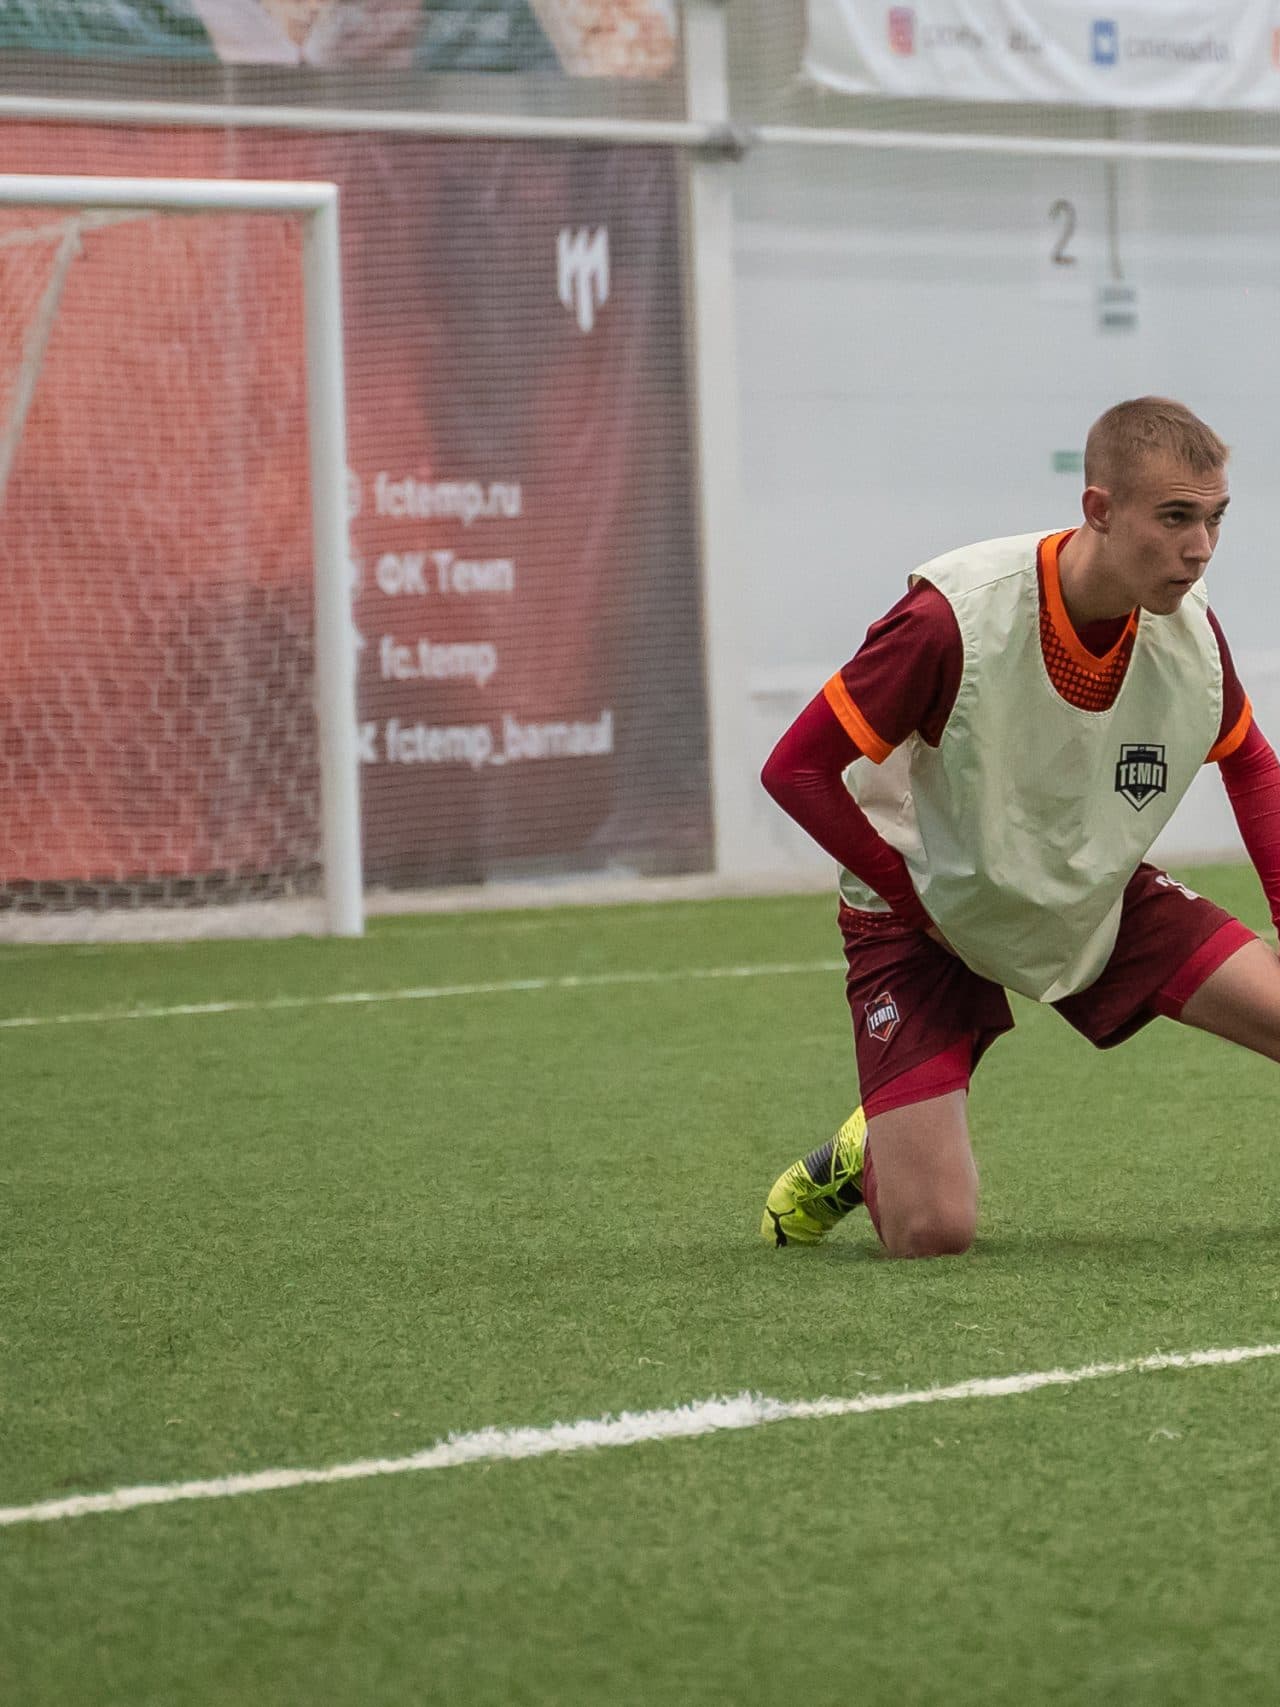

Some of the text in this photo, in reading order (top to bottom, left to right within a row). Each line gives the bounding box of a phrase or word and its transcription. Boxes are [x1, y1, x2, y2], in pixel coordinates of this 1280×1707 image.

[1050, 199, 1078, 267] 2
[375, 471, 522, 526] fctemp.ru
[376, 550, 515, 596] ФК Темп
[380, 634, 497, 688] fc.temp
[386, 708, 614, 768] fctemp_barnaul
[1119, 762, 1164, 788] ТЕМП
[869, 1005, 895, 1031] ТЕМП
